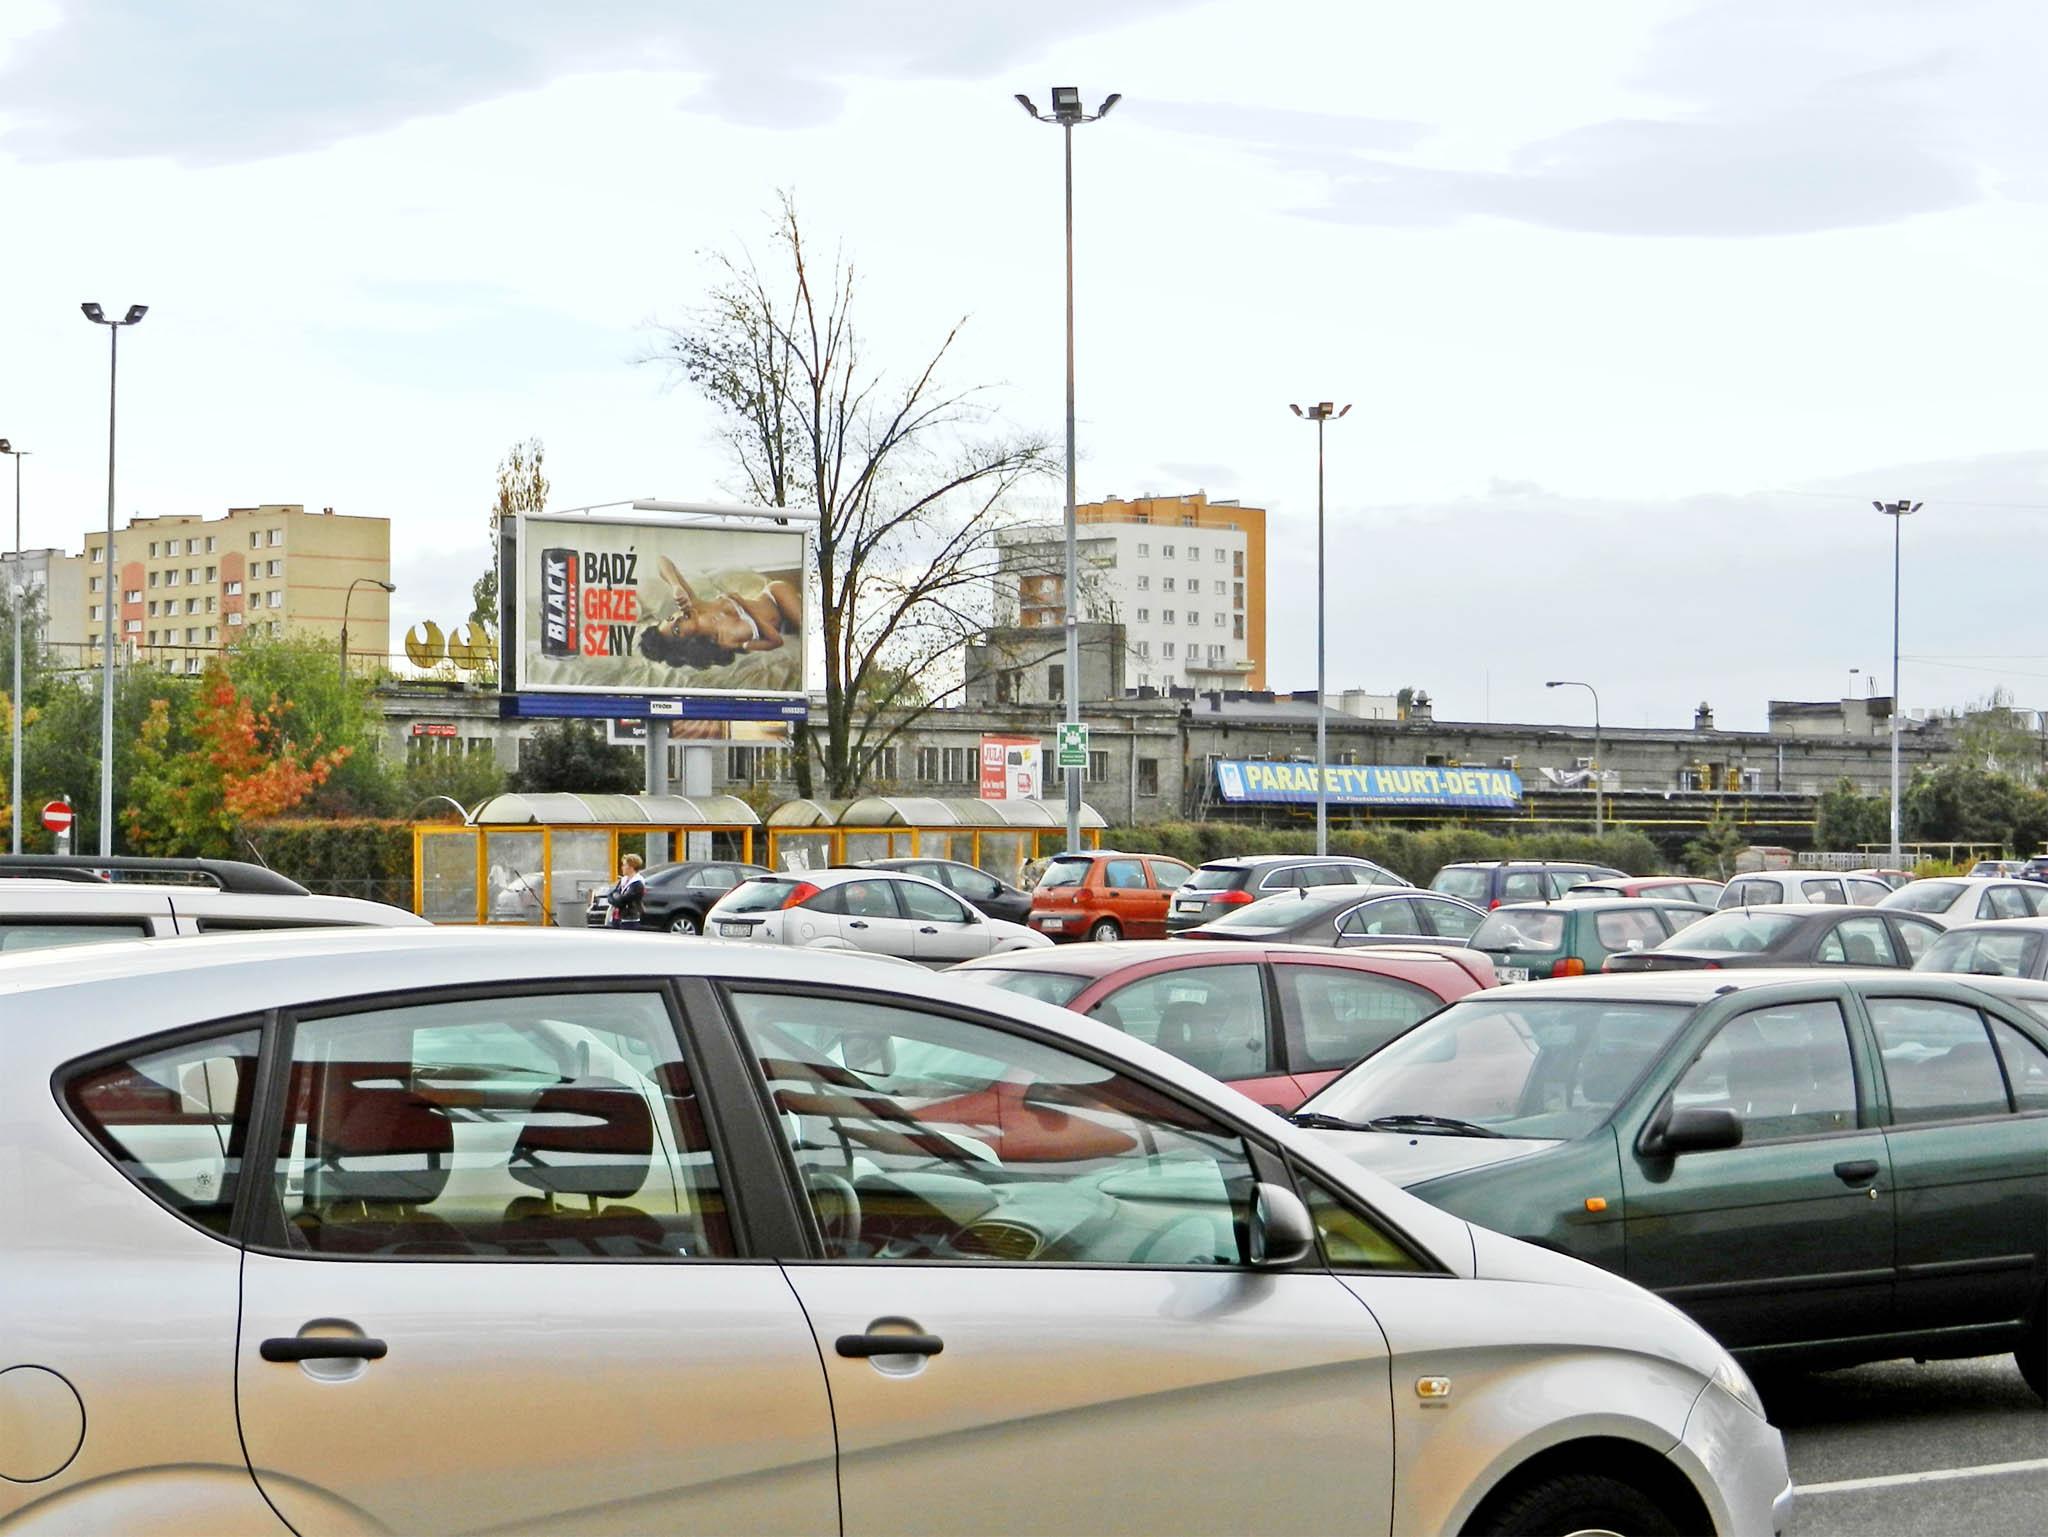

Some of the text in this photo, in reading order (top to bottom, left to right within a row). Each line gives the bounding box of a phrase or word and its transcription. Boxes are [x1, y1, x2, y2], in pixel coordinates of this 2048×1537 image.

[584, 546, 638, 591] BĄDŹ
[547, 557, 567, 642] BLACK
[584, 588, 637, 622] GRZE
[584, 624, 636, 657] SZNY
[1374, 769, 1518, 800] HURT-DETAL
